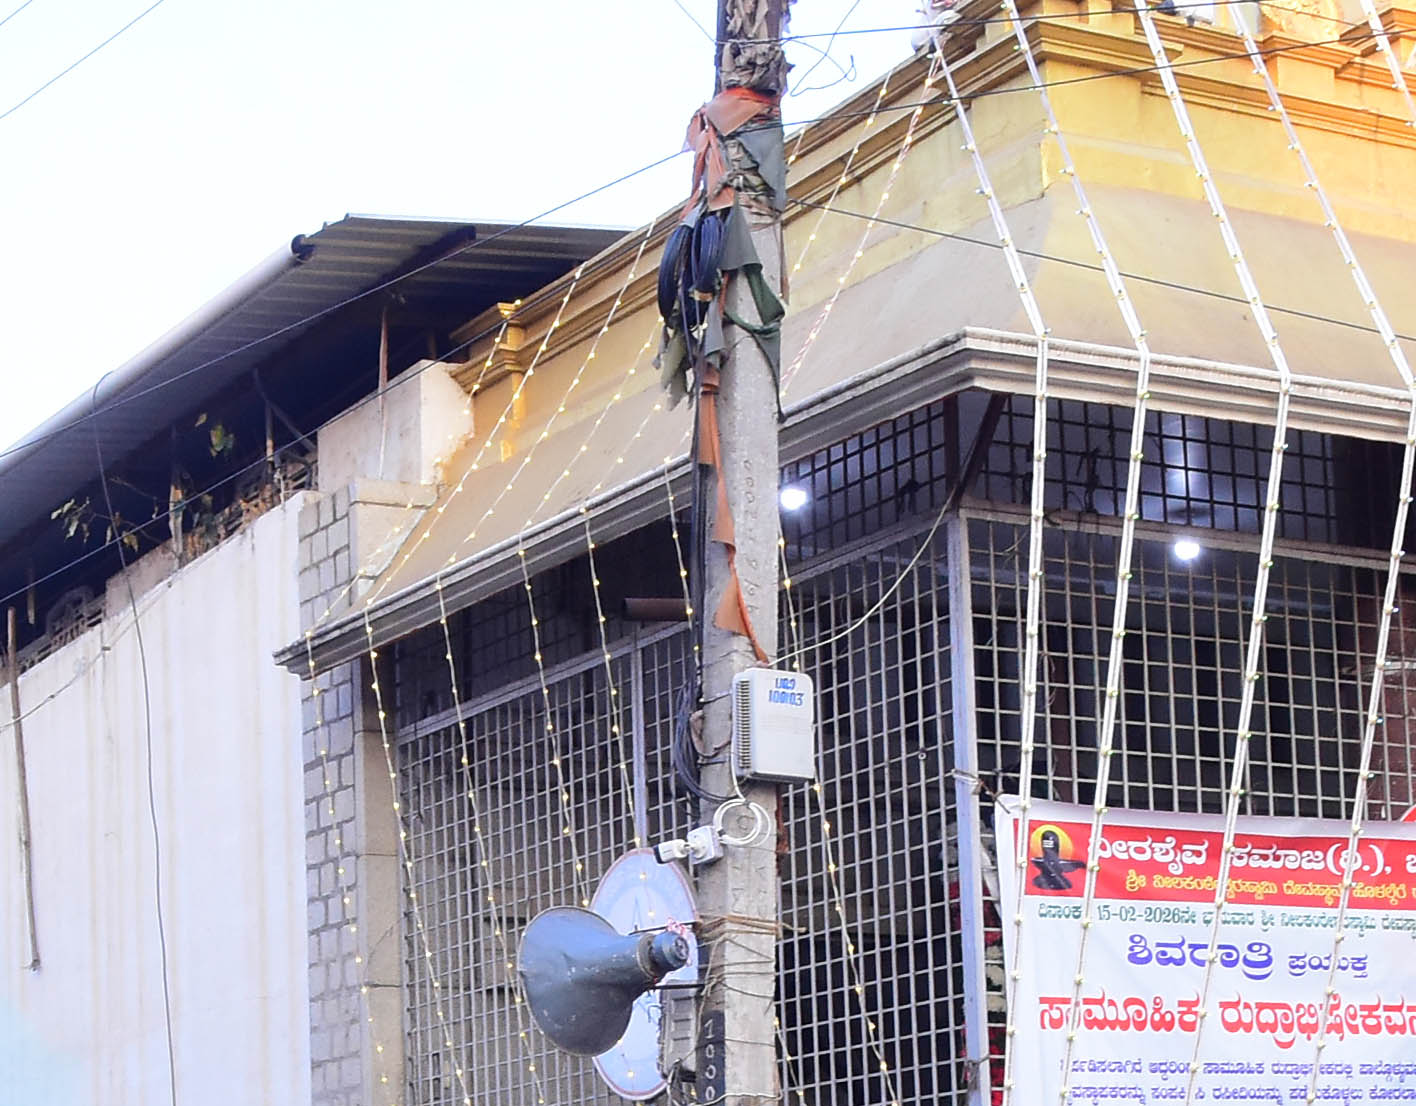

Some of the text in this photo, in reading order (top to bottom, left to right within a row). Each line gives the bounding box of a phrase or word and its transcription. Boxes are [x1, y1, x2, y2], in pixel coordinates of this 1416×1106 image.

[1125, 869, 1147, 892] ಶ್ರೀ
[1127, 933, 1369, 981] ಶಿವರಾತ್ರಿ ಪ್ರಯುಕ್ತ
[1038, 986, 1202, 1033] ಸಾಮೂಹಿಕ
